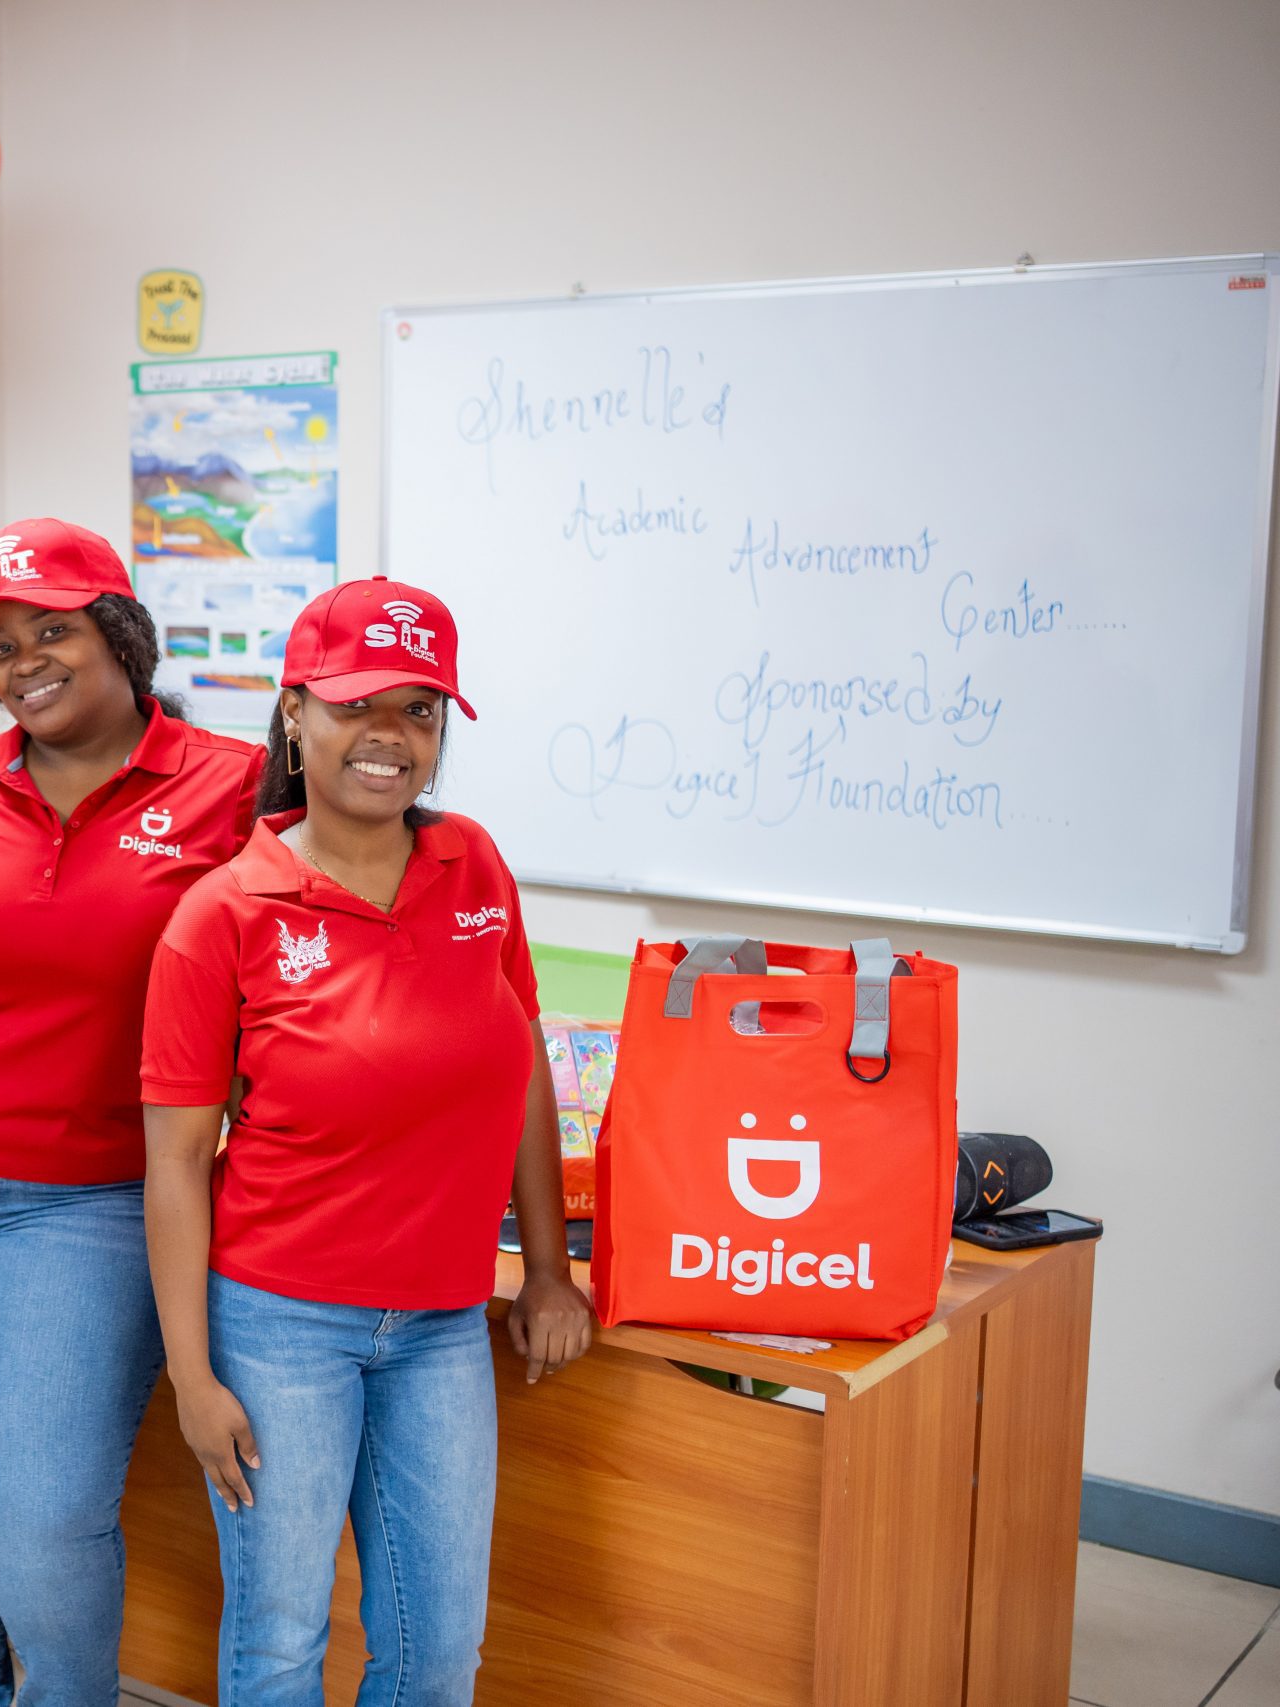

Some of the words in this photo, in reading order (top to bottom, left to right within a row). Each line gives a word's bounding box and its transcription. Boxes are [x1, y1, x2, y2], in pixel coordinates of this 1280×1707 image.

[562, 480, 709, 561] Academic
[729, 516, 939, 608] Advancement
[942, 674, 1002, 747] by
[119, 835, 183, 859] Digicel
[670, 1233, 874, 1296] Digicel
